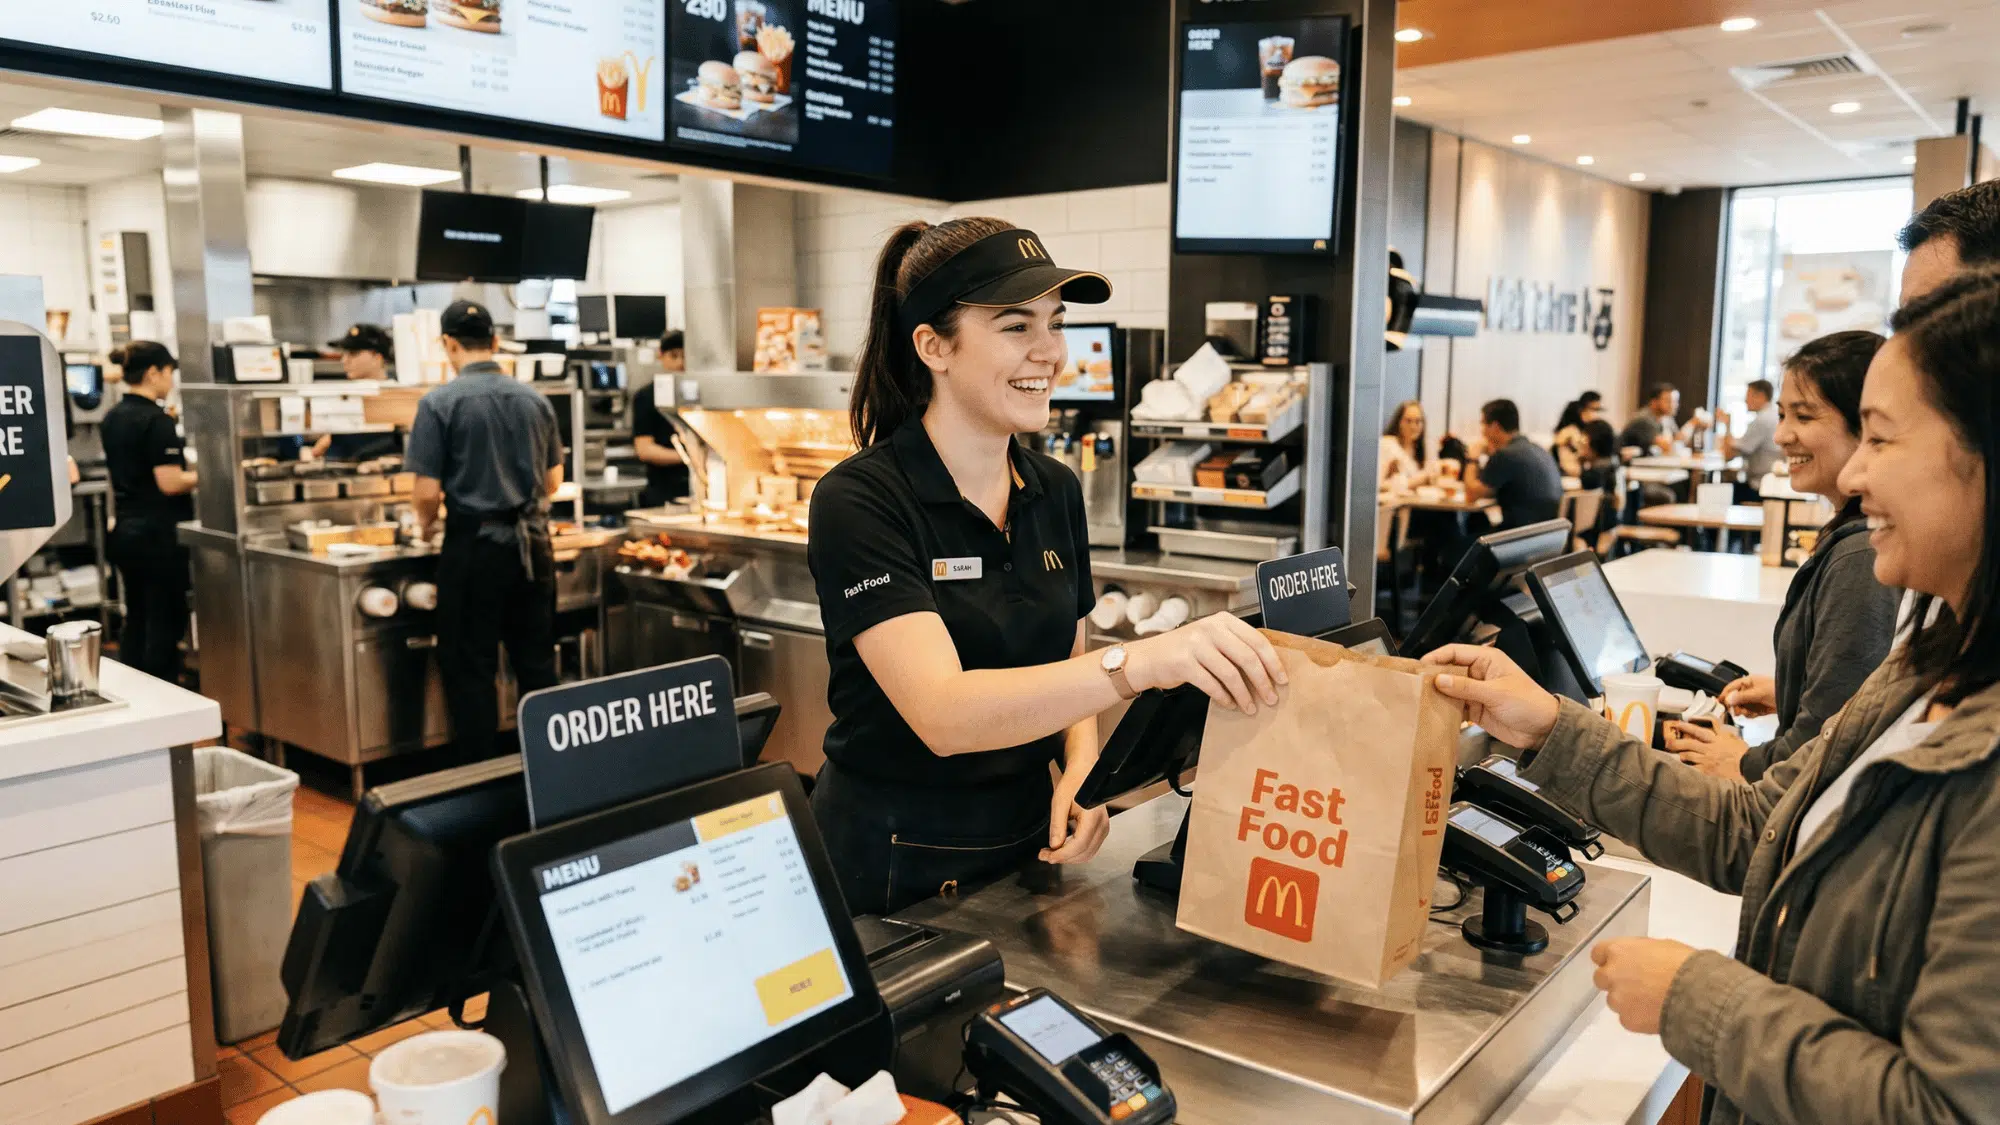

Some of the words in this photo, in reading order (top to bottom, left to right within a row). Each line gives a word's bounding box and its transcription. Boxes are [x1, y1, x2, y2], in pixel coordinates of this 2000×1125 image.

[806, 0, 865, 25] MENU
[863, 572, 891, 590] Food
[1269, 570, 1309, 601] ORDER
[1310, 563, 1340, 591] HERE
[547, 697, 644, 752] ORDER
[648, 680, 716, 728] HERE
[1251, 768, 1346, 825] Fast
[1237, 806, 1348, 868] Food
[542, 854, 601, 890] MENU
